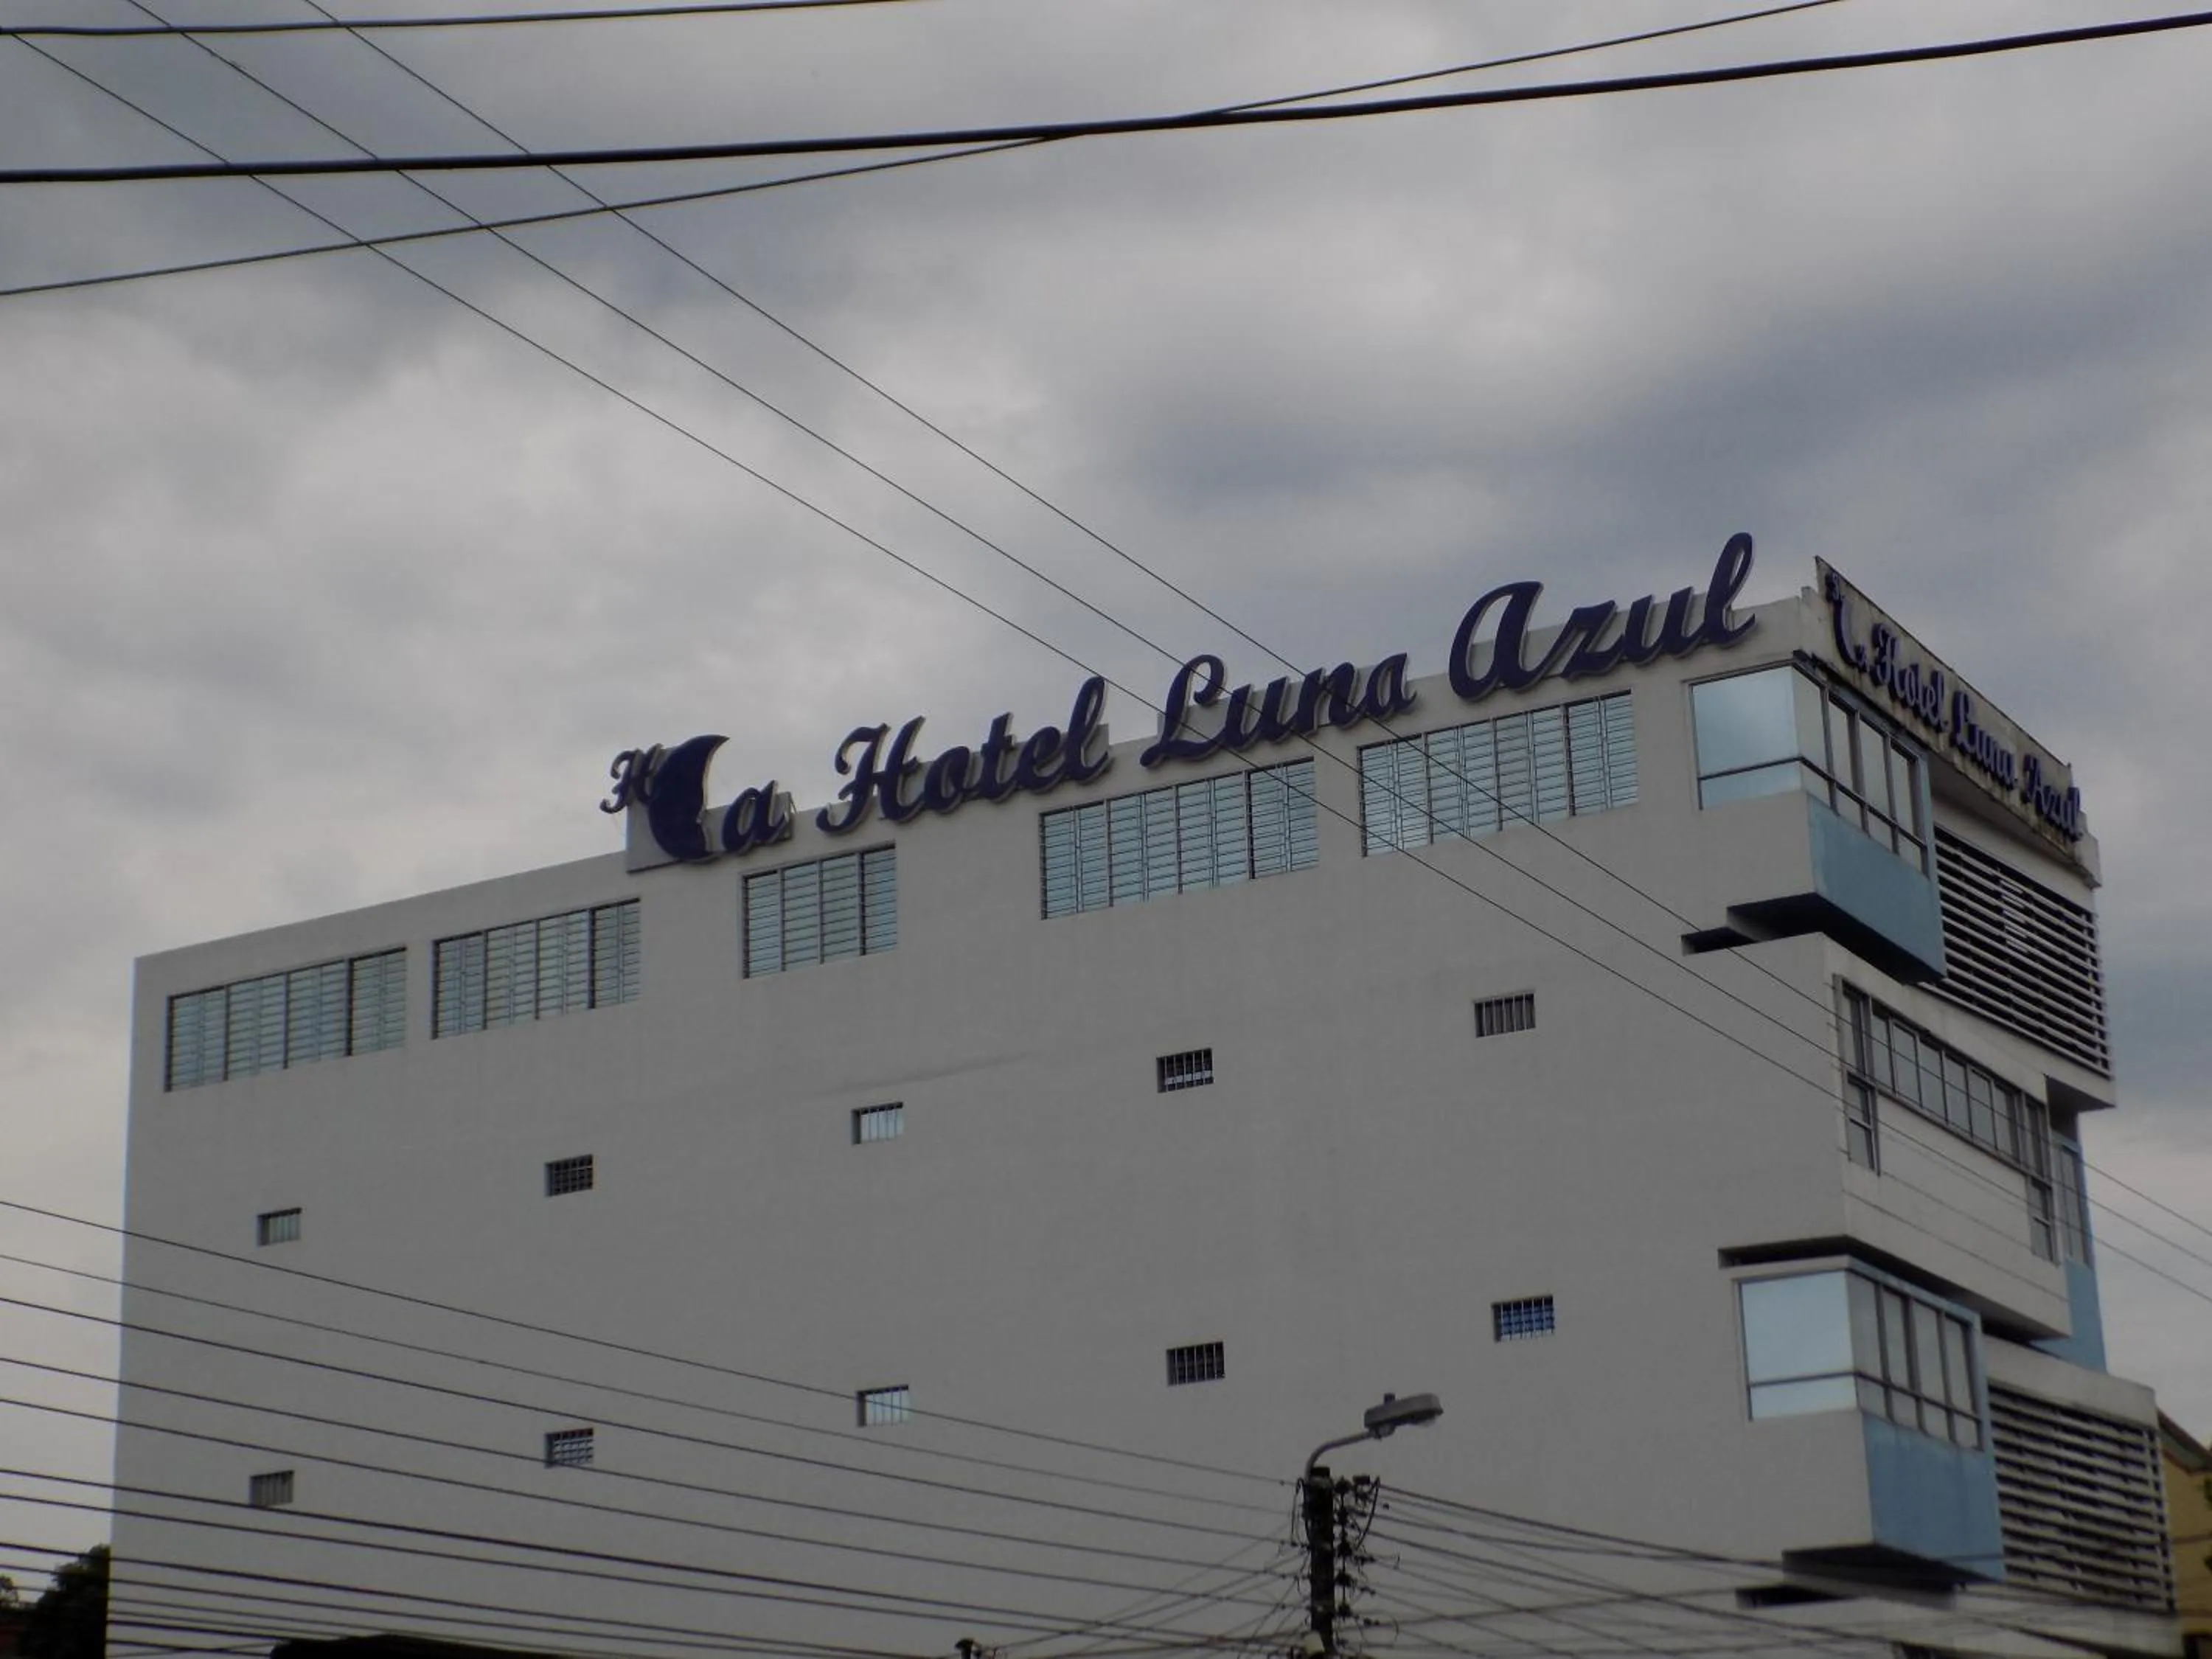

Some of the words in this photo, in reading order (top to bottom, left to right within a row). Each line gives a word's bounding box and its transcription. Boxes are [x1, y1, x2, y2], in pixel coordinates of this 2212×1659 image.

[815, 676, 1112, 833] Hotel
[1140, 653, 1417, 768] Luna
[1448, 532, 1756, 701] Azul
[1868, 622, 1948, 733] Hotel
